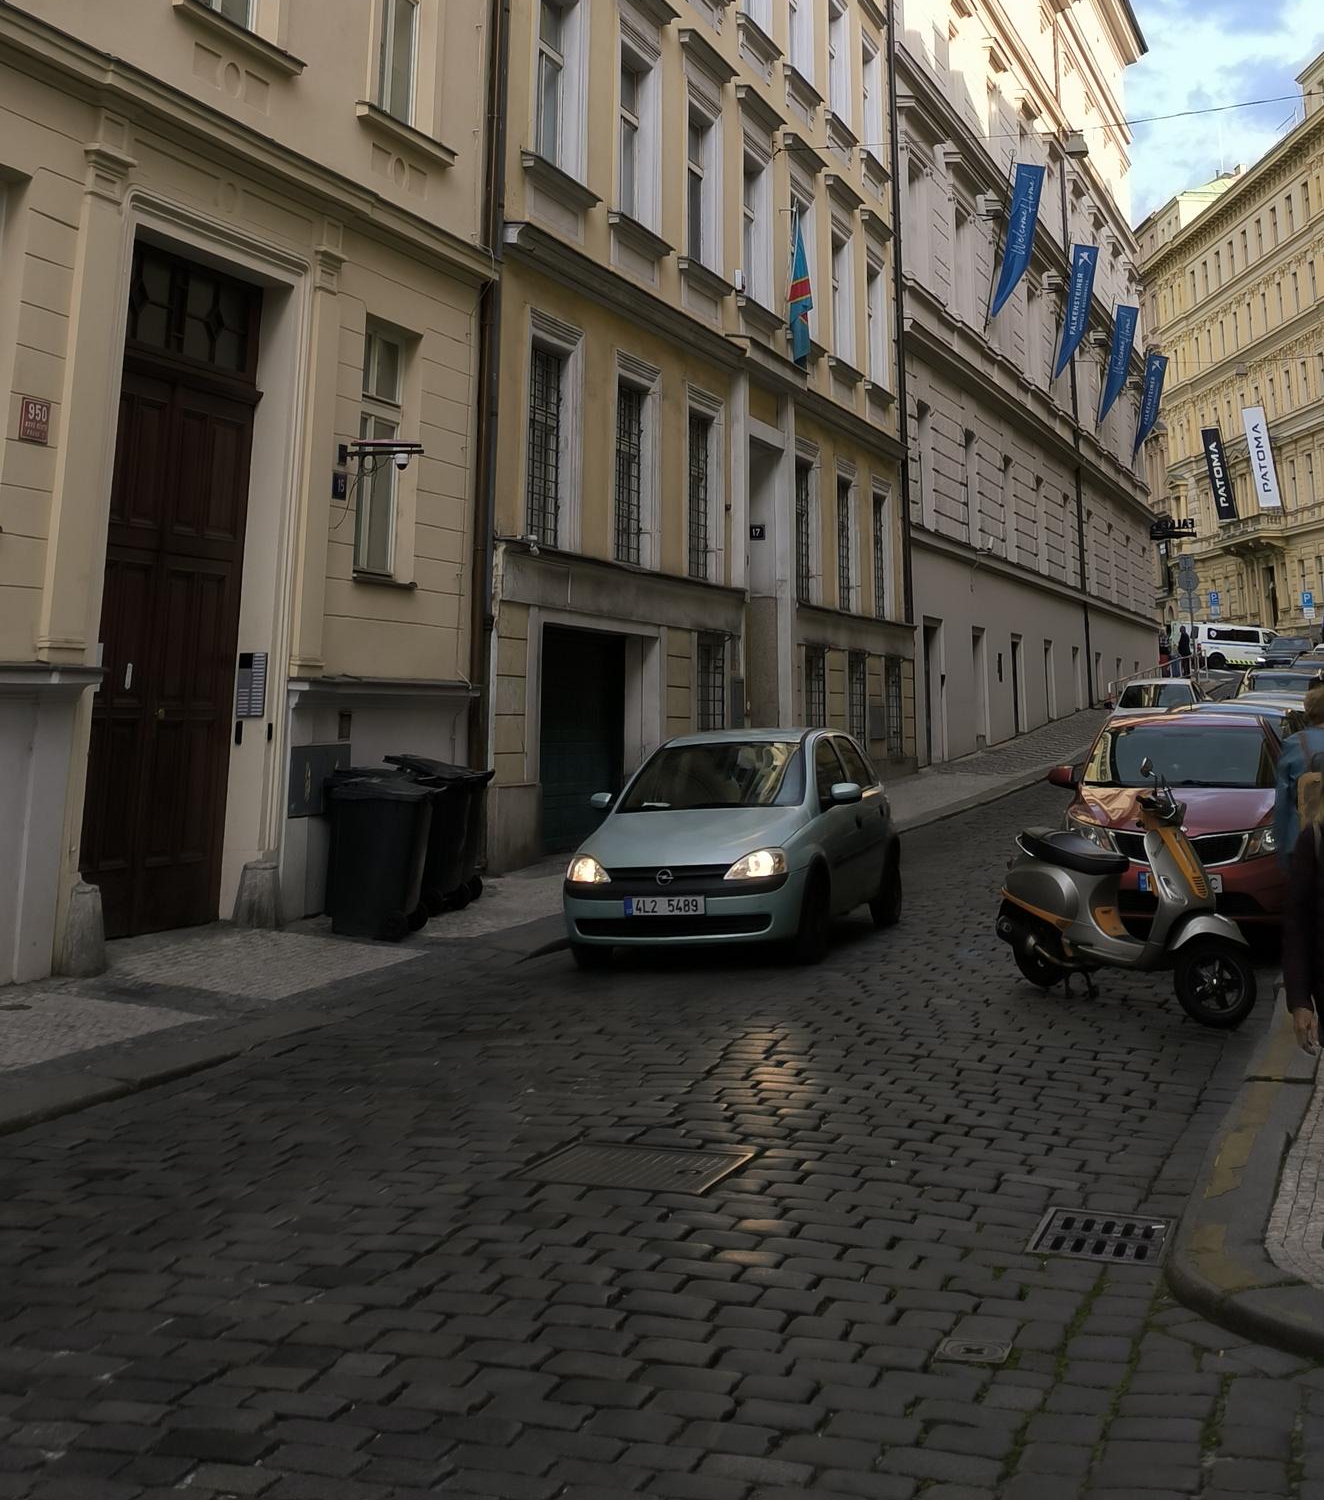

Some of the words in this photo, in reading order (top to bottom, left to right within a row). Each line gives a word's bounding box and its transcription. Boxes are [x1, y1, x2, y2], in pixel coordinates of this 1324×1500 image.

[1010, 209, 1027, 255] Welcome
[1019, 172, 1037, 213] Home!
[1069, 272, 1084, 336] FALKENSTEINER
[28, 403, 48, 422] 950
[1250, 423, 1273, 493] PATOMA
[1204, 441, 1229, 508] PATOMA
[337, 479, 345, 493] 15
[752, 528, 761, 537] 17
[1303, 593, 1311, 603] P
[635, 899, 658, 914] 4L2
[667, 898, 698, 913] 5489
